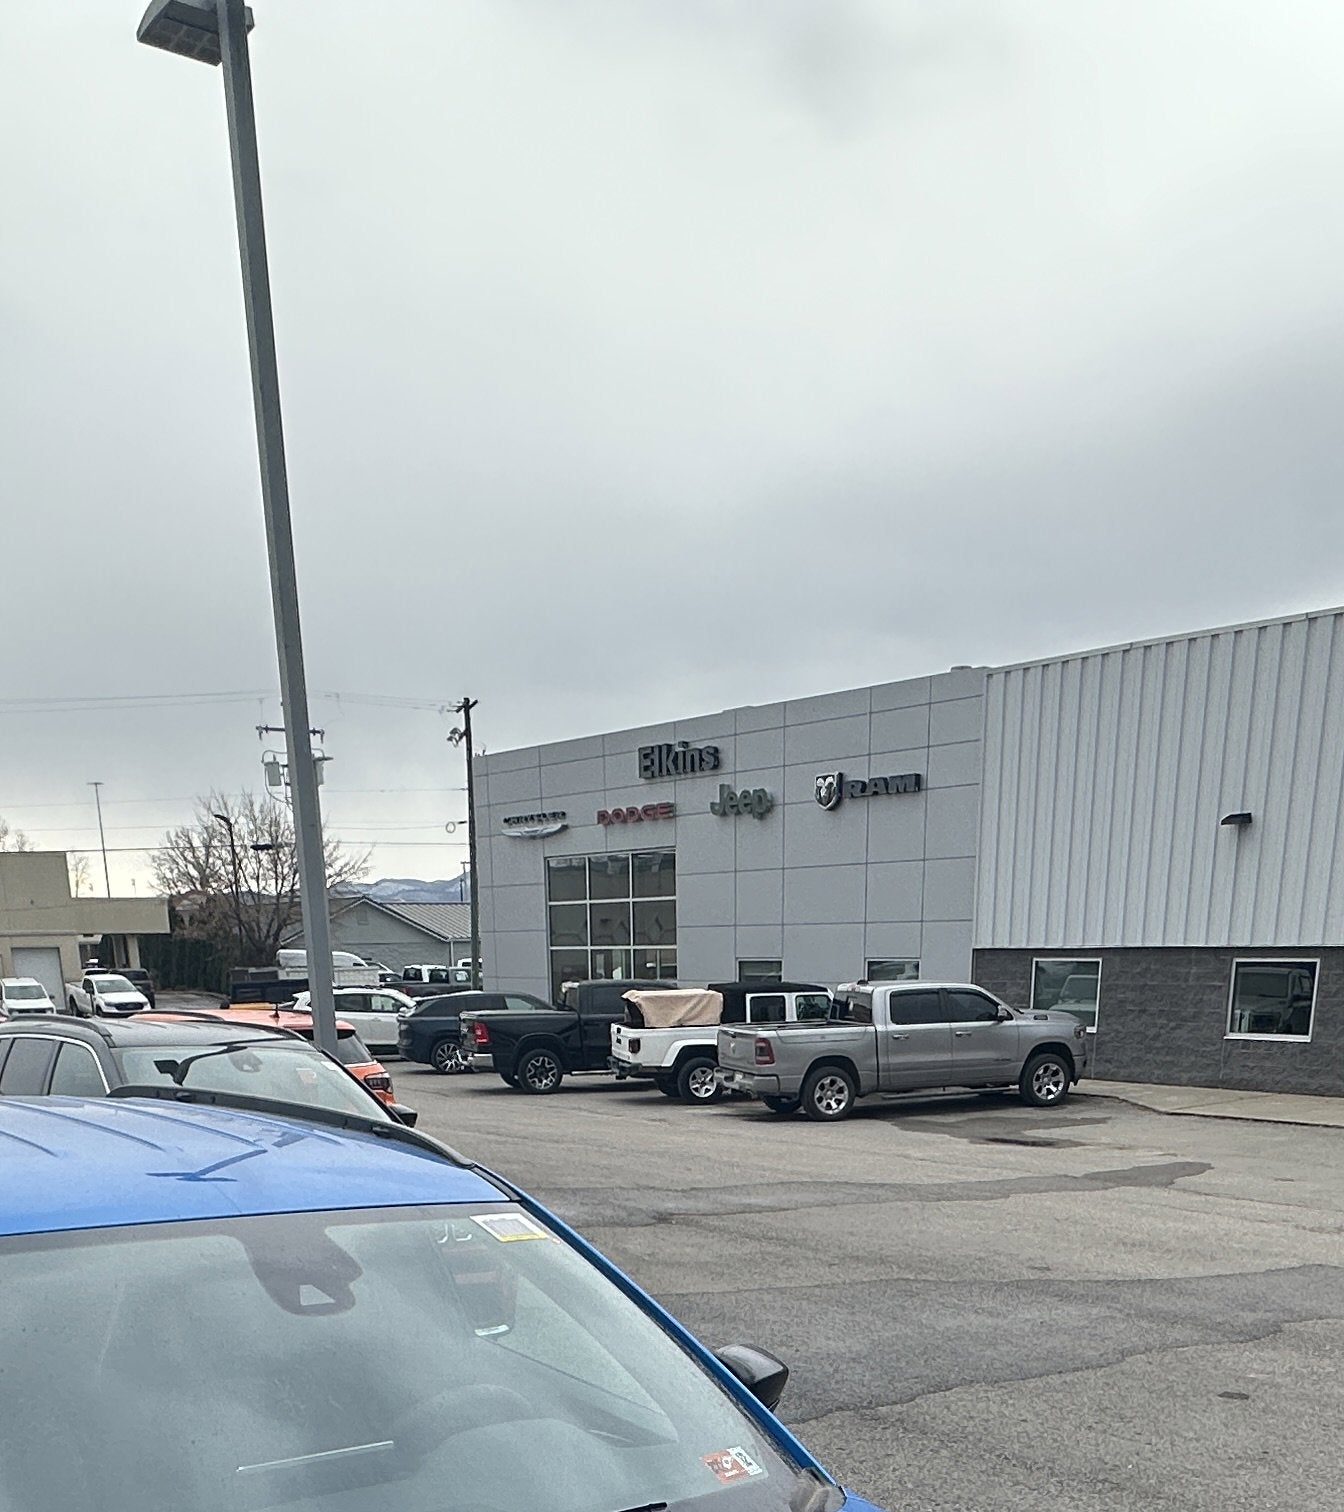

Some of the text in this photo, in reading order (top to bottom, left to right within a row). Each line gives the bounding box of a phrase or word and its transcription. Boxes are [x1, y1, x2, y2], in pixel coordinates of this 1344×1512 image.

[638, 741, 719, 779] Elkins
[843, 773, 921, 798] RAM
[597, 802, 675, 826] DODGE
[710, 783, 772, 820] Jeep
